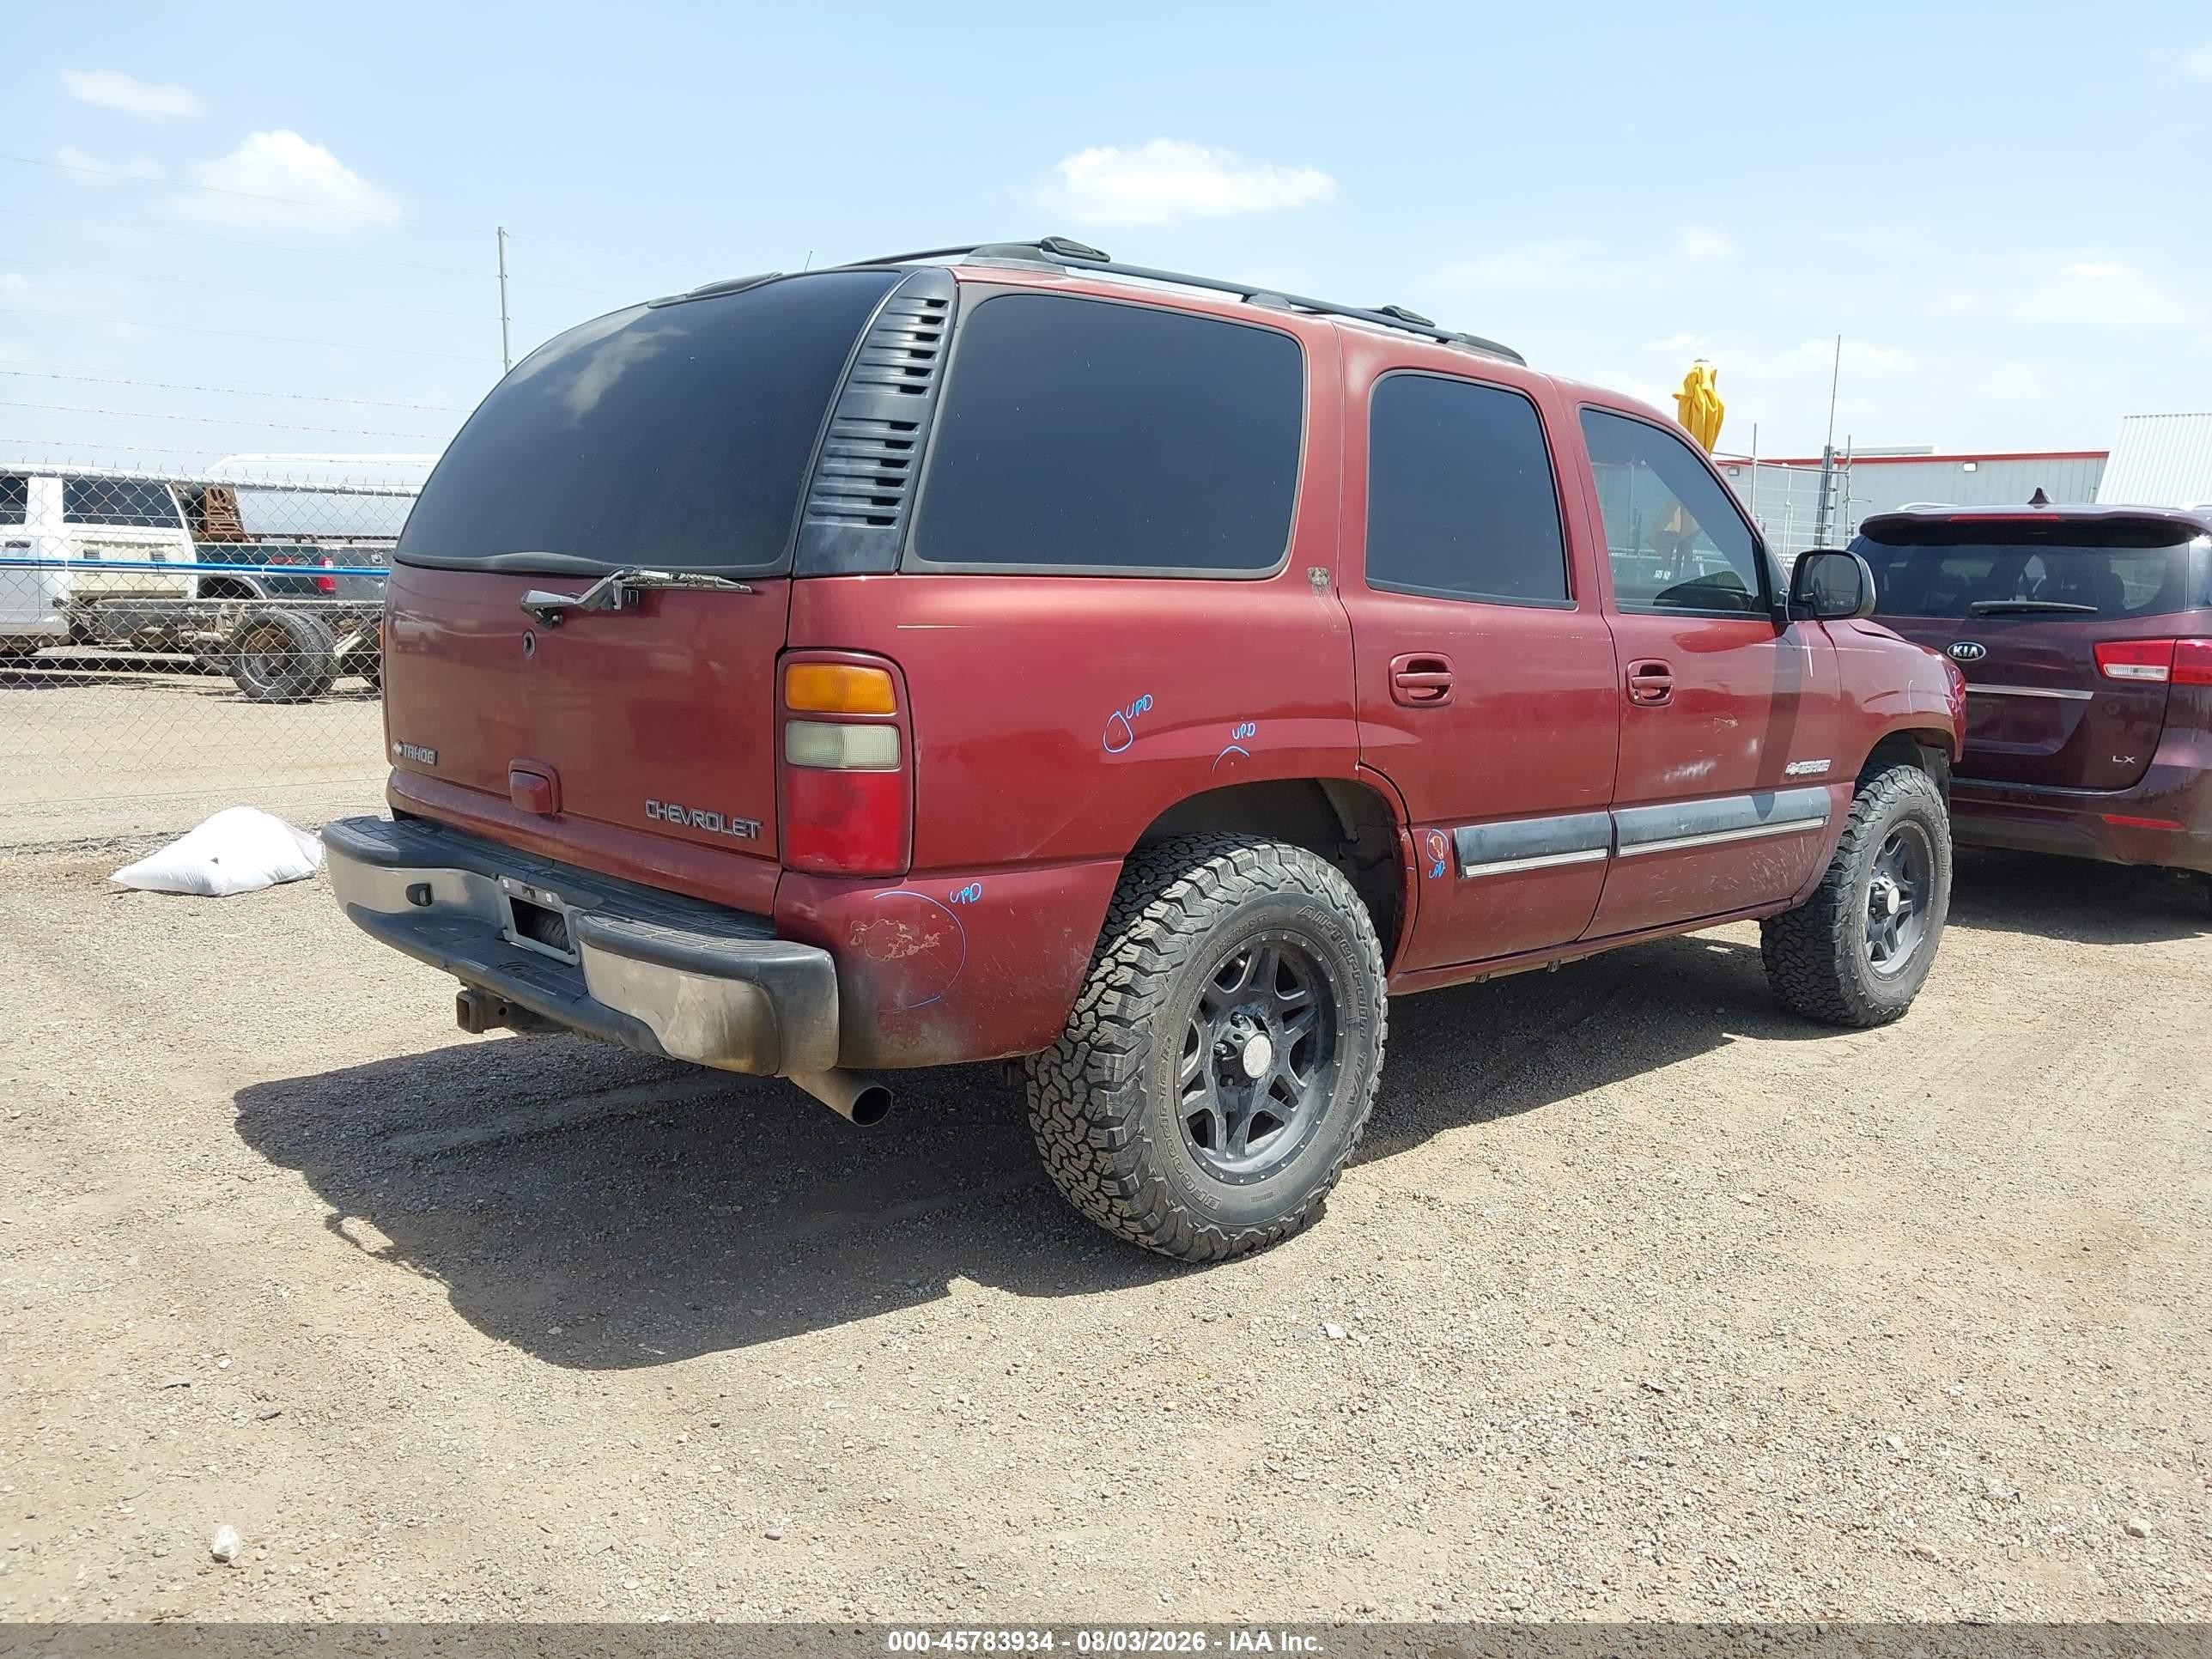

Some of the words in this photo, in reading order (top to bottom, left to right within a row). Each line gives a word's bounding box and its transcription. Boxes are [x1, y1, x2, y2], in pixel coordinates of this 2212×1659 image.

[1953, 645, 1979, 658] KIA
[1126, 694, 1154, 711] UPD
[1232, 722, 1256, 740] UPD
[404, 744, 434, 764] TAHOE
[2112, 755, 2136, 764] LX
[645, 799, 763, 840] CHEVROLET
[950, 882, 982, 905] UPD
